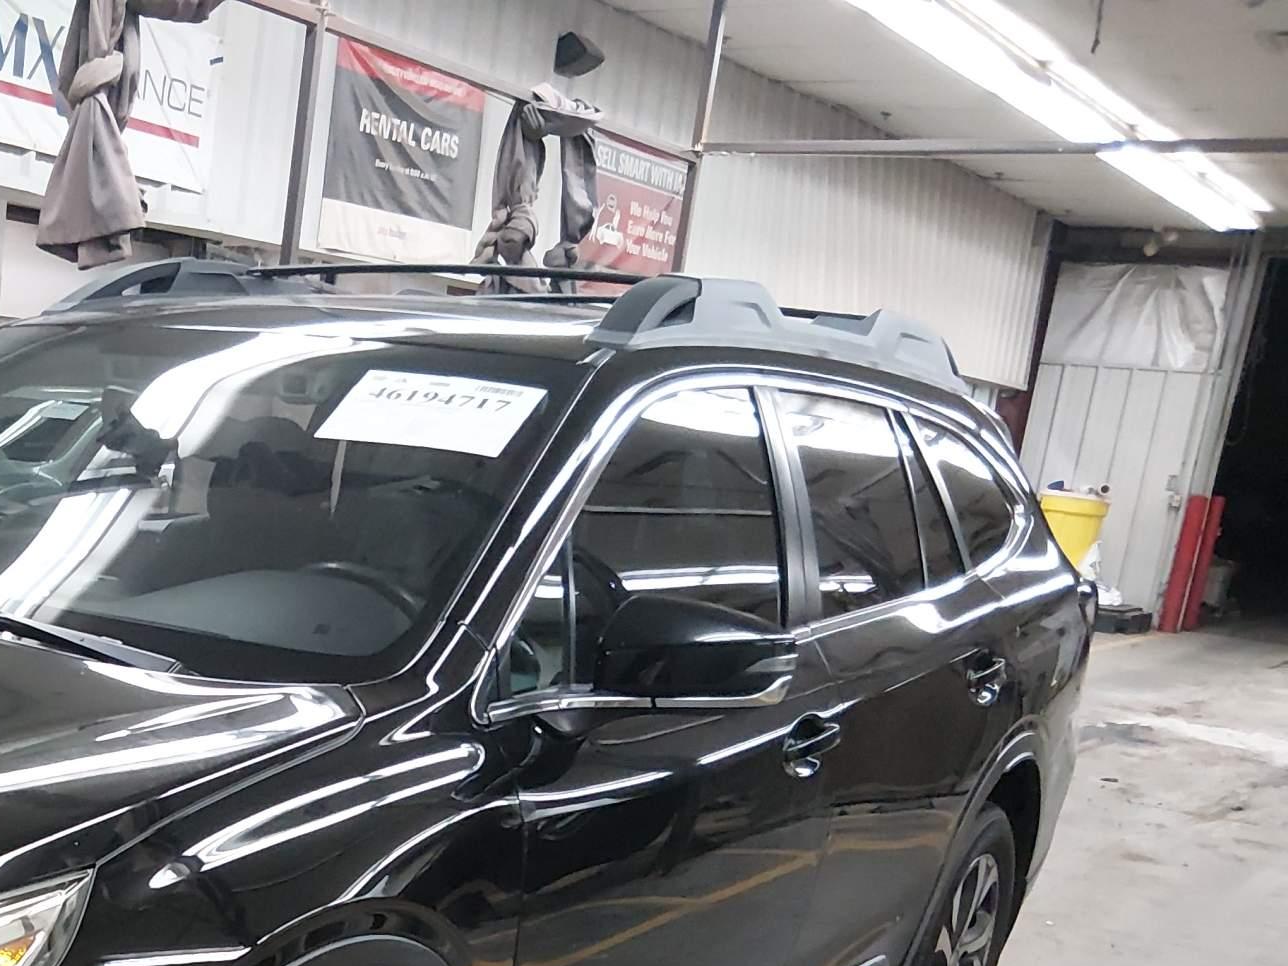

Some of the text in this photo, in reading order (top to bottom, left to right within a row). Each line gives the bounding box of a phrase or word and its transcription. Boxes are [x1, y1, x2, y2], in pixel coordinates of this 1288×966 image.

[359, 107, 460, 159] RENTAL CARS
[597, 145, 617, 173] SELL
[618, 153, 650, 183] SMART
[651, 163, 674, 191] WITH
[369, 387, 512, 412] 46194717
